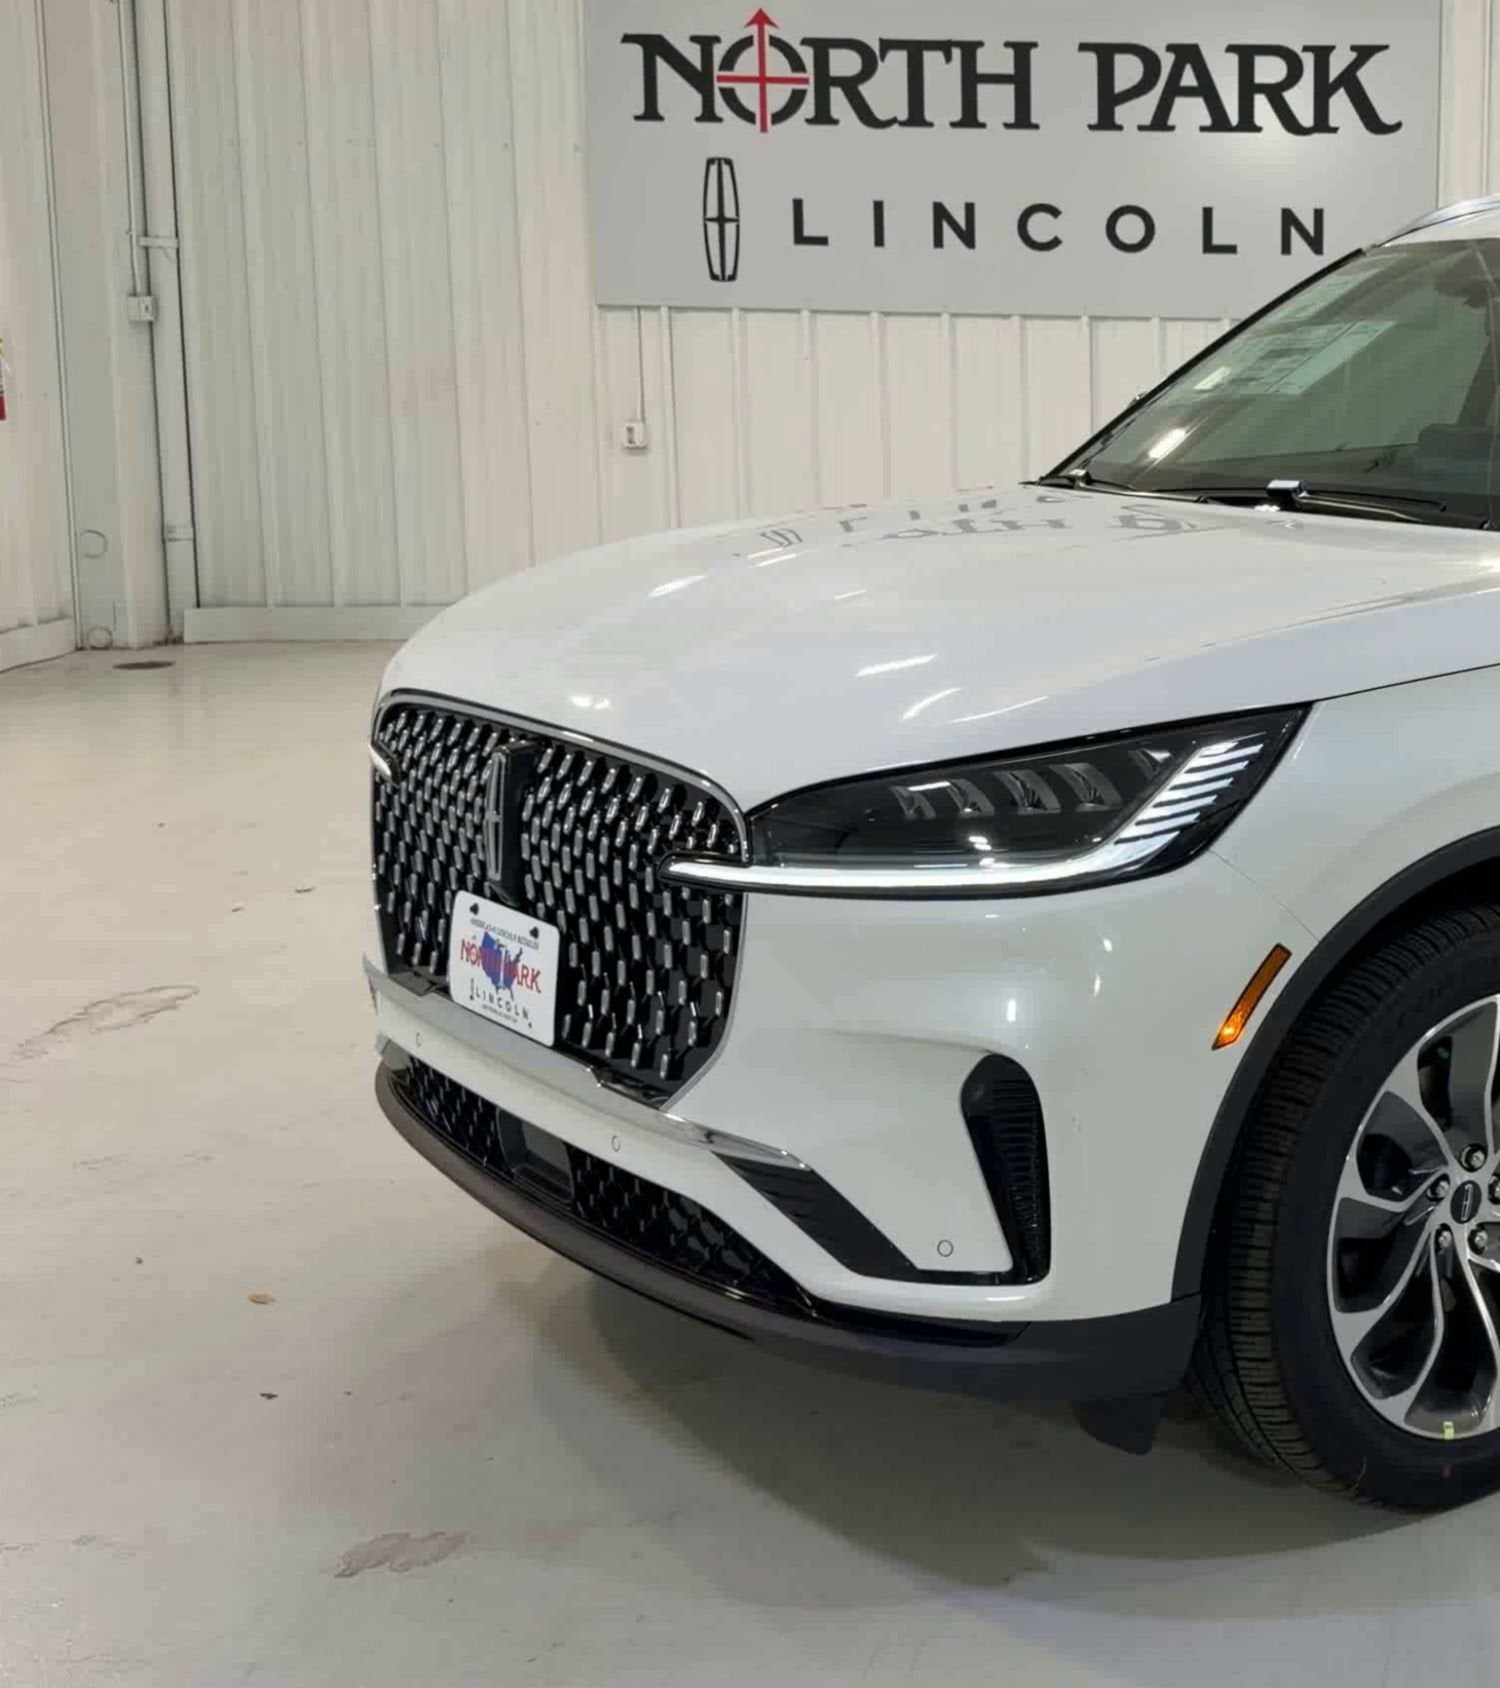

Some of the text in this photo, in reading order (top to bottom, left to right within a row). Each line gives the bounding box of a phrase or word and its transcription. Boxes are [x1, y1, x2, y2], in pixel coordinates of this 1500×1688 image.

[620, 32, 1403, 137] NORTH PARK
[792, 198, 1326, 257] LINCOLN
[476, 985, 530, 1021] LINCOLN
